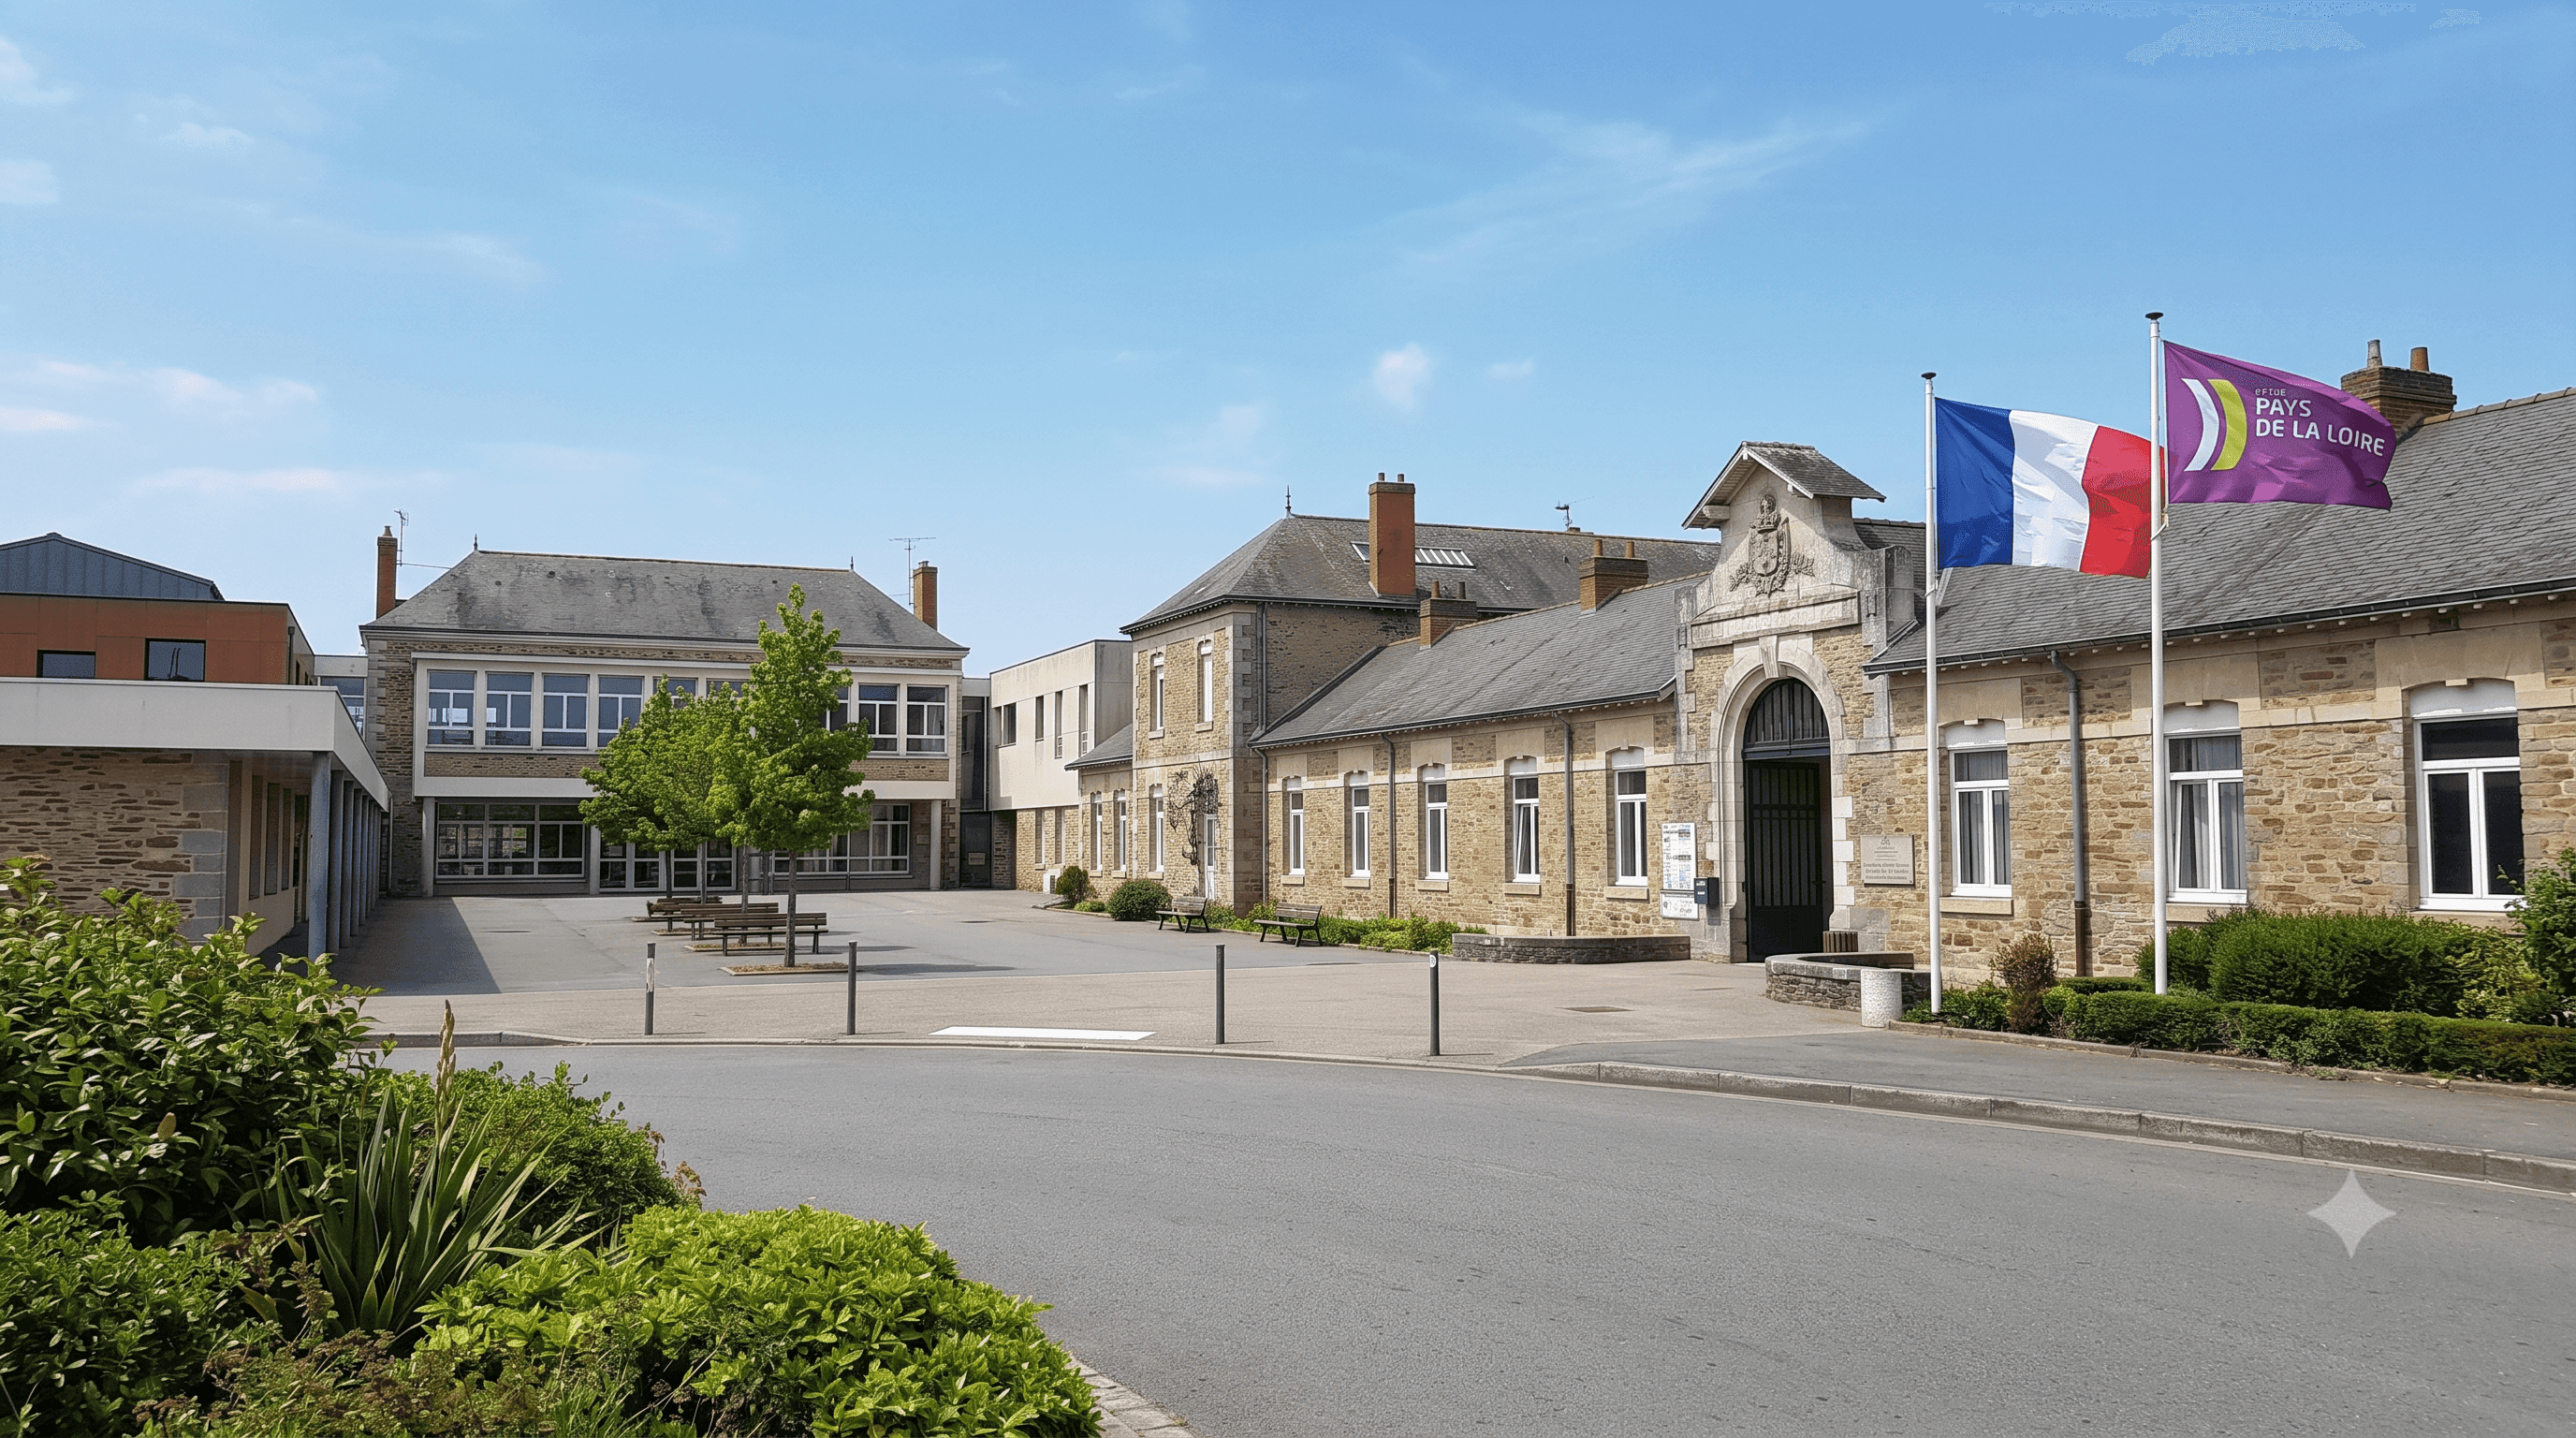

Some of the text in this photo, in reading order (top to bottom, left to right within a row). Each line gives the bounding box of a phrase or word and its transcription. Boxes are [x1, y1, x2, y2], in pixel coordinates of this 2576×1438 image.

[2256, 397, 2312, 418] PAYS
[2256, 418, 2385, 457] DE LA LOIRE
